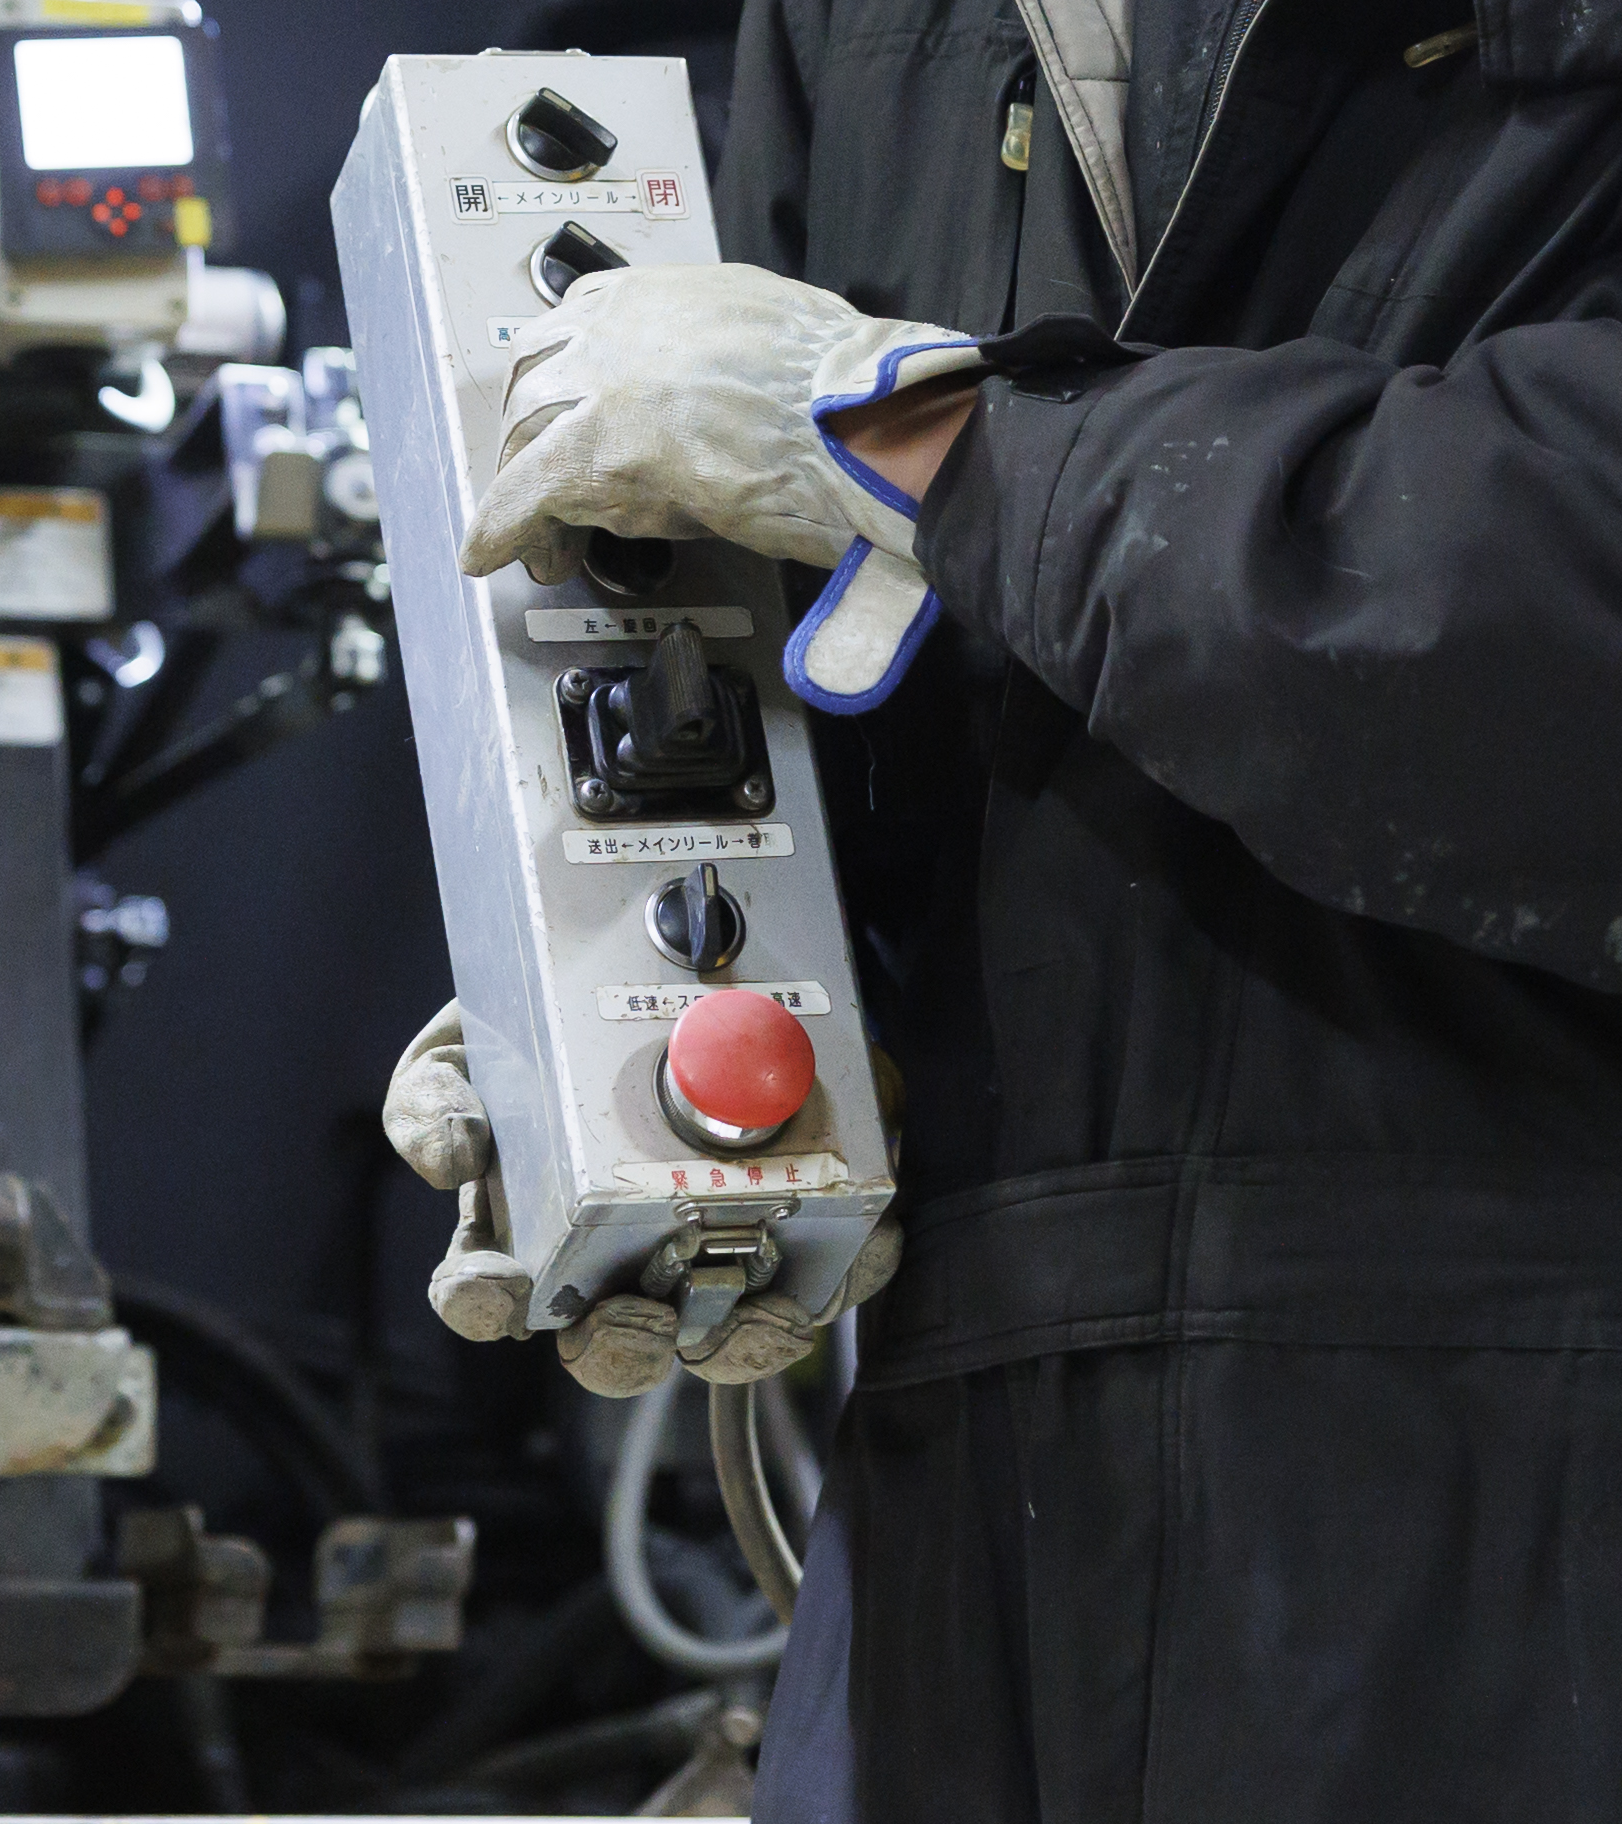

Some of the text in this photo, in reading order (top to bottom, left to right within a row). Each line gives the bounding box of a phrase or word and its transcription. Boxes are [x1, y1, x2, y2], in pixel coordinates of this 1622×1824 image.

[455, 179, 680, 213] 開 メインリール 閉
[584, 618, 600, 634] 左
[587, 838, 619, 855] 送出
[638, 834, 729, 853] メインリール
[671, 1163, 803, 1190] 緊急停止
